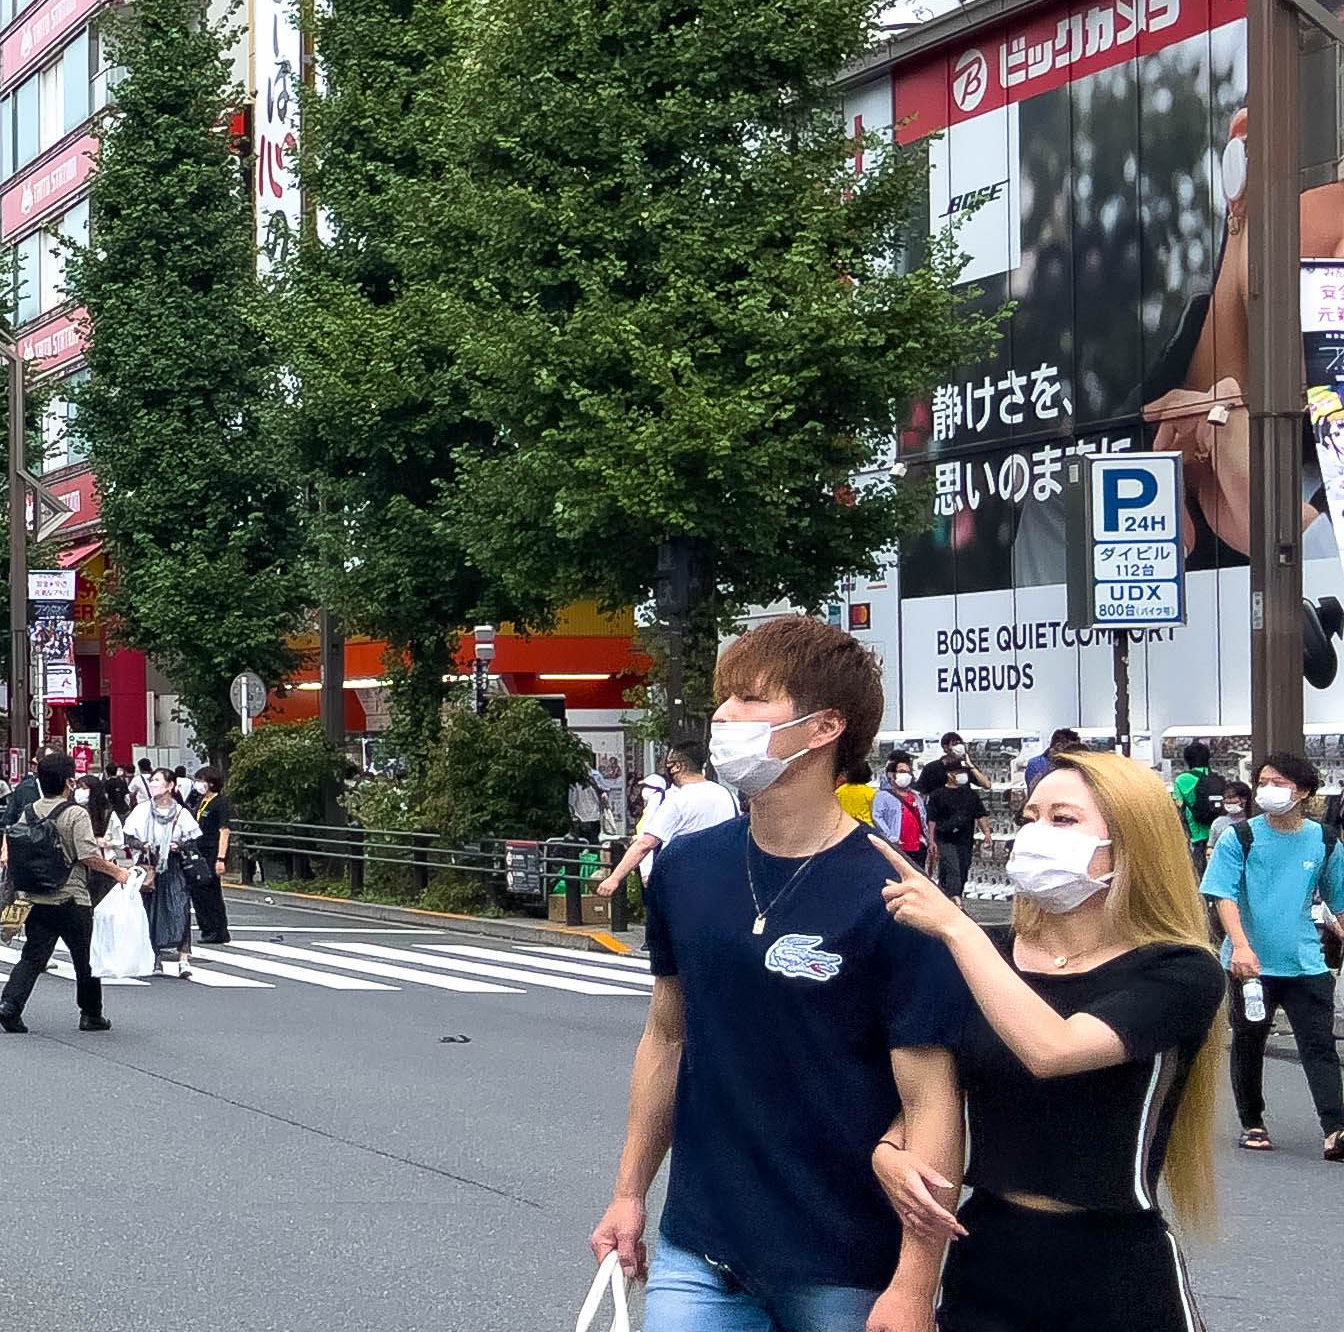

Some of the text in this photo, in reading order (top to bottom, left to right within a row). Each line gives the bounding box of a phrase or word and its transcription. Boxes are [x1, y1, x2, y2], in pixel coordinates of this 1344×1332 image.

[931, 361, 1074, 442] 静けさを、
[1102, 468, 1166, 533] P 24H
[1099, 545, 1171, 562] ダイビル
[1115, 563, 1156, 578] 112台
[1109, 584, 1162, 602] UDX
[936, 626, 990, 657] BOSE
[937, 662, 1035, 693] EARBUDS
